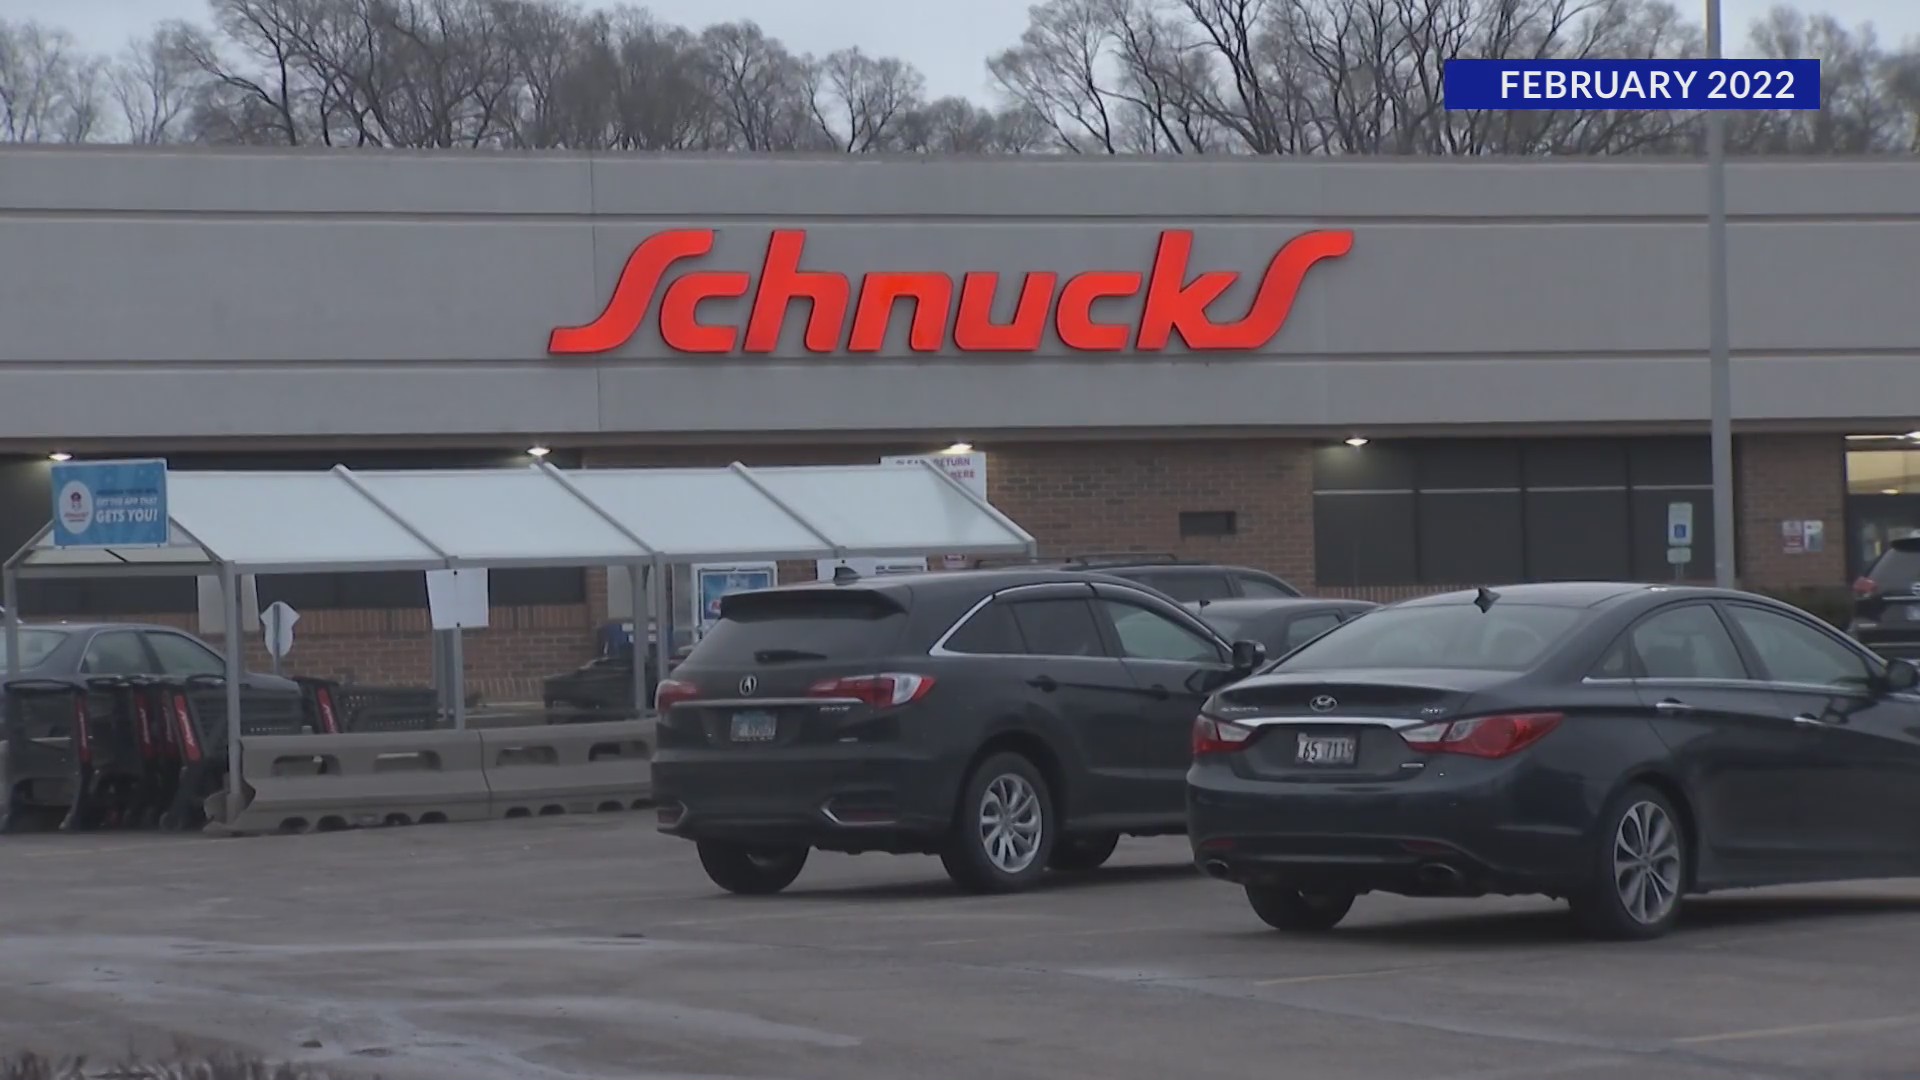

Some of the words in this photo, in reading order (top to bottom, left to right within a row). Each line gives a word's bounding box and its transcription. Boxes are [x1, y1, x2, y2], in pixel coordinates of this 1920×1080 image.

[549, 229, 1354, 353] Schnucks
[96, 509, 125, 523] GETS
[127, 508, 158, 522] YOU!
